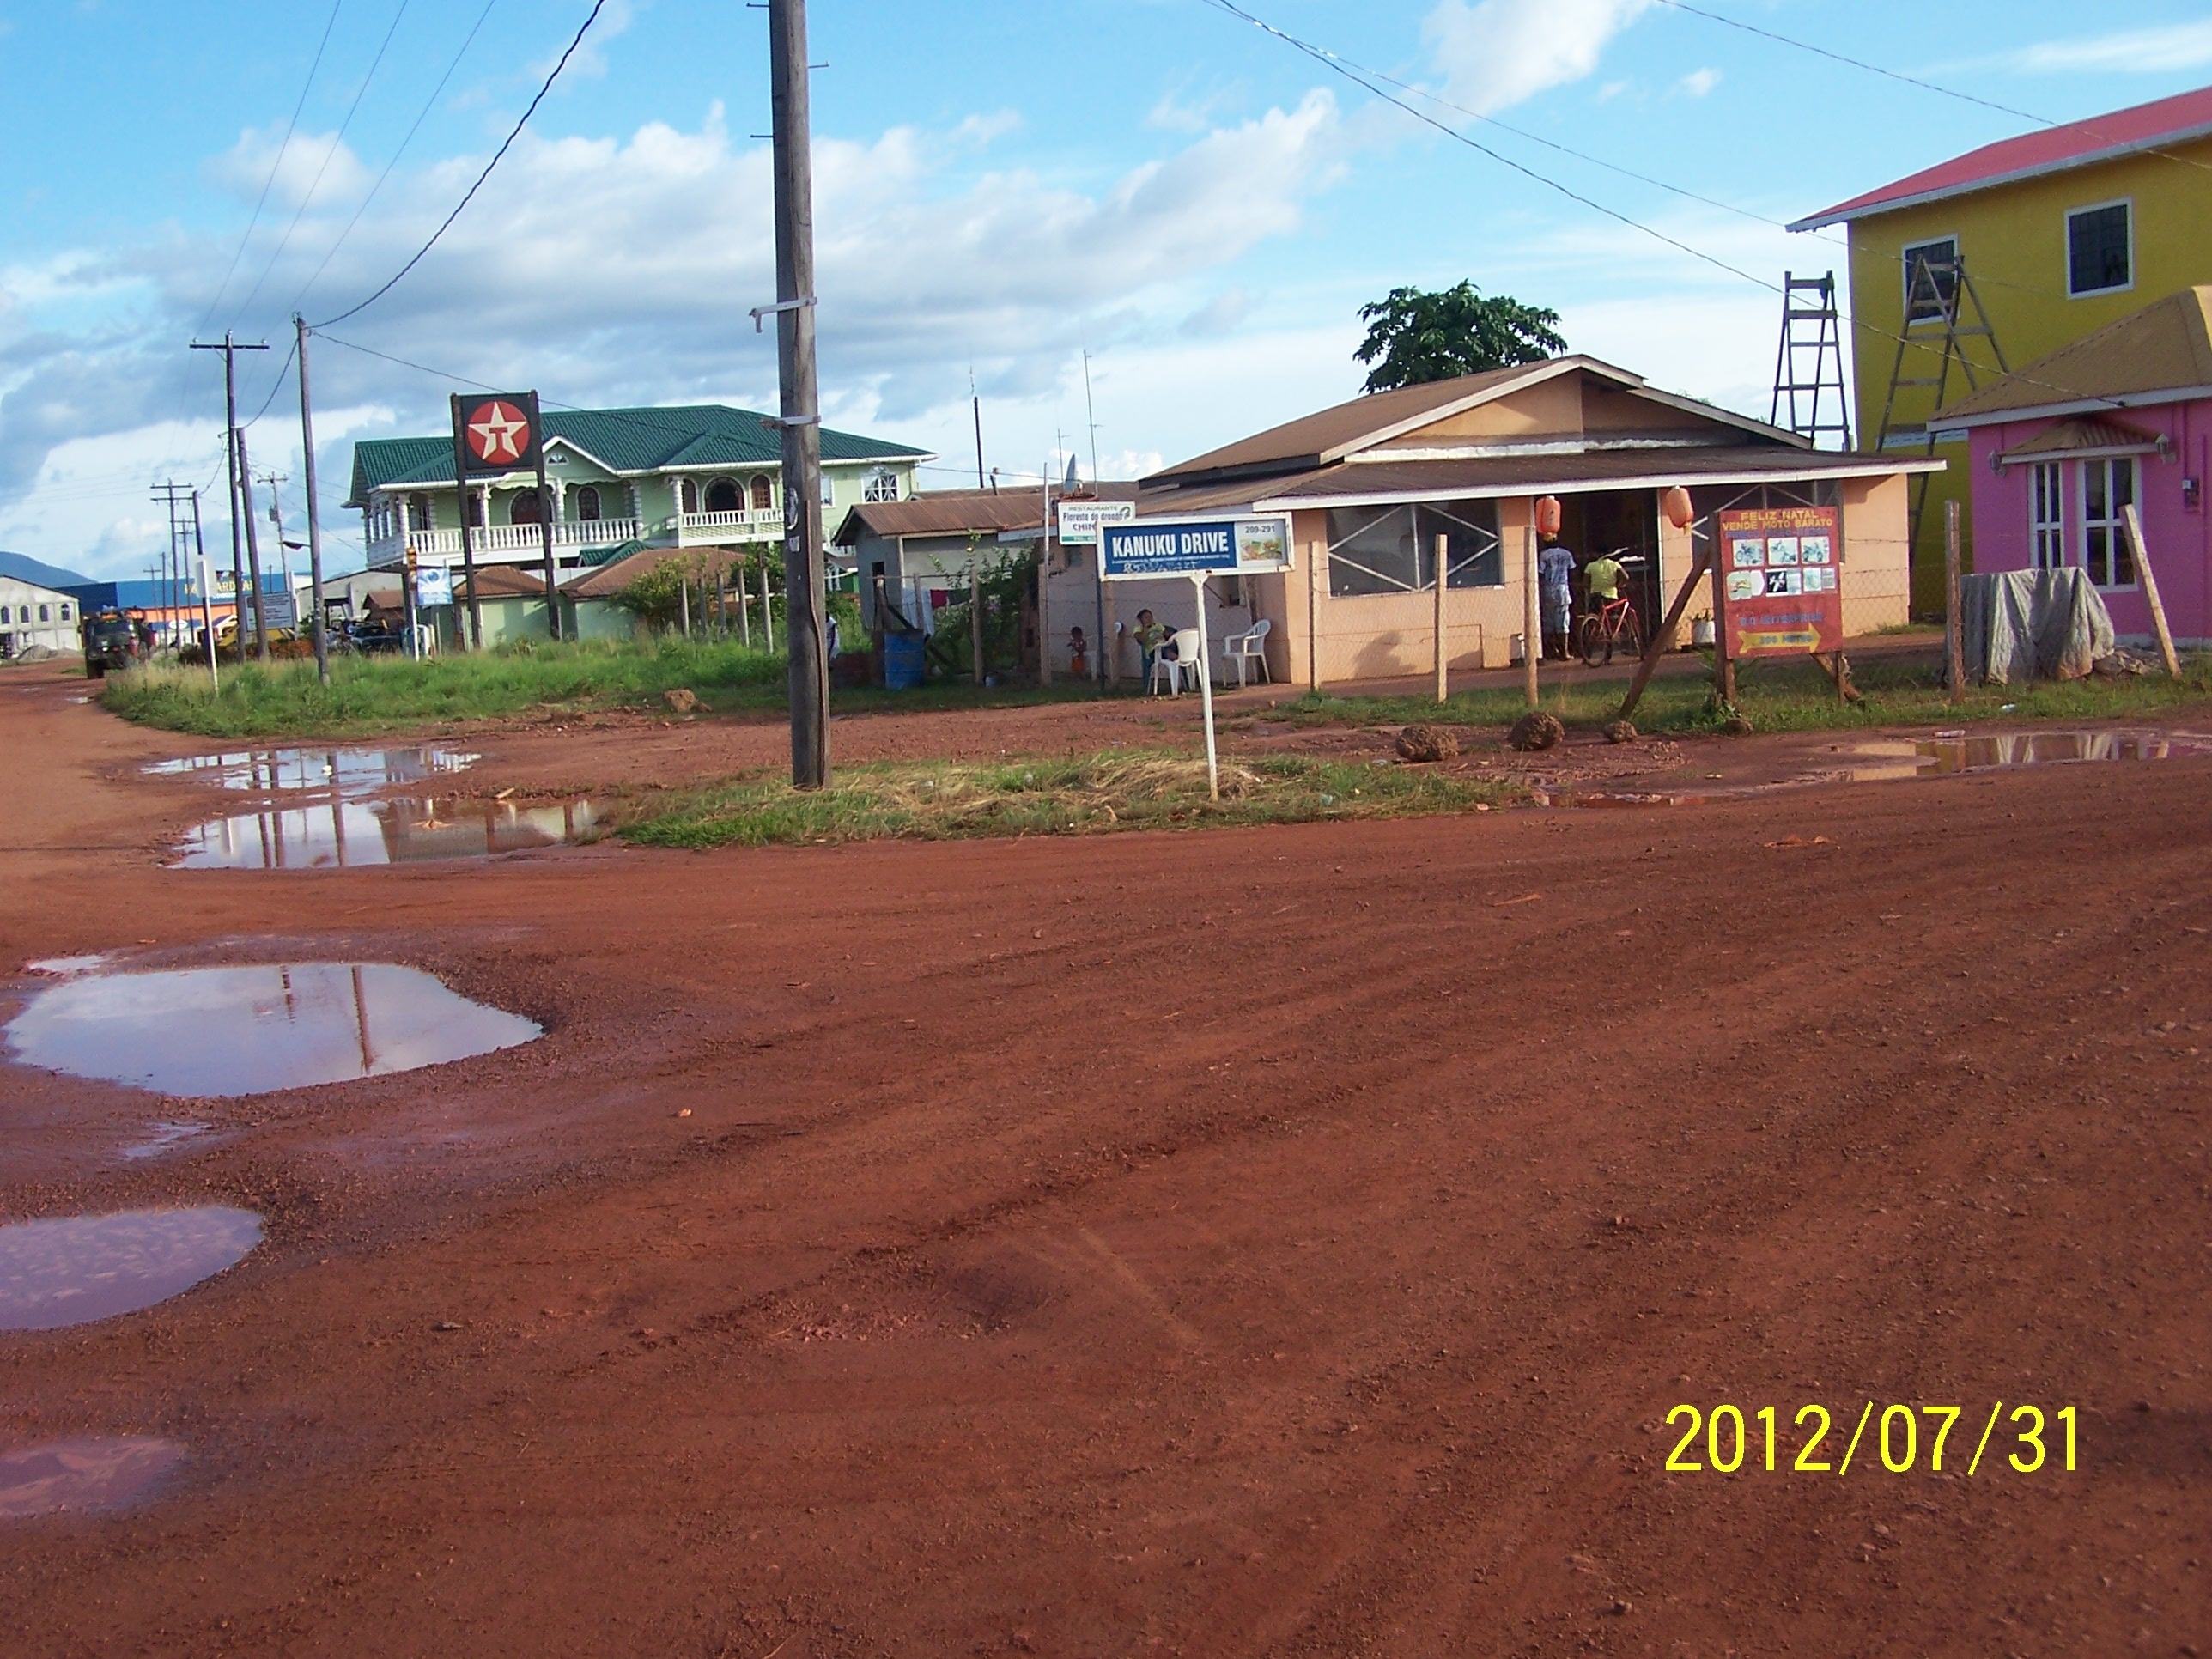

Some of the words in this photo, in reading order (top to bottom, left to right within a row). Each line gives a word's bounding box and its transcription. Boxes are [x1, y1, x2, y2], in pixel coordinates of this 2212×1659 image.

[1741, 511, 1778, 521] FELIZ
[1782, 510, 1819, 520] NATAL
[1723, 520, 1758, 531] VENDE
[1762, 520, 1790, 529] MOTO
[1795, 518, 1832, 528] BARATO
[1111, 534, 1176, 558] KANUKU
[1181, 532, 1229, 555] DRIVE
